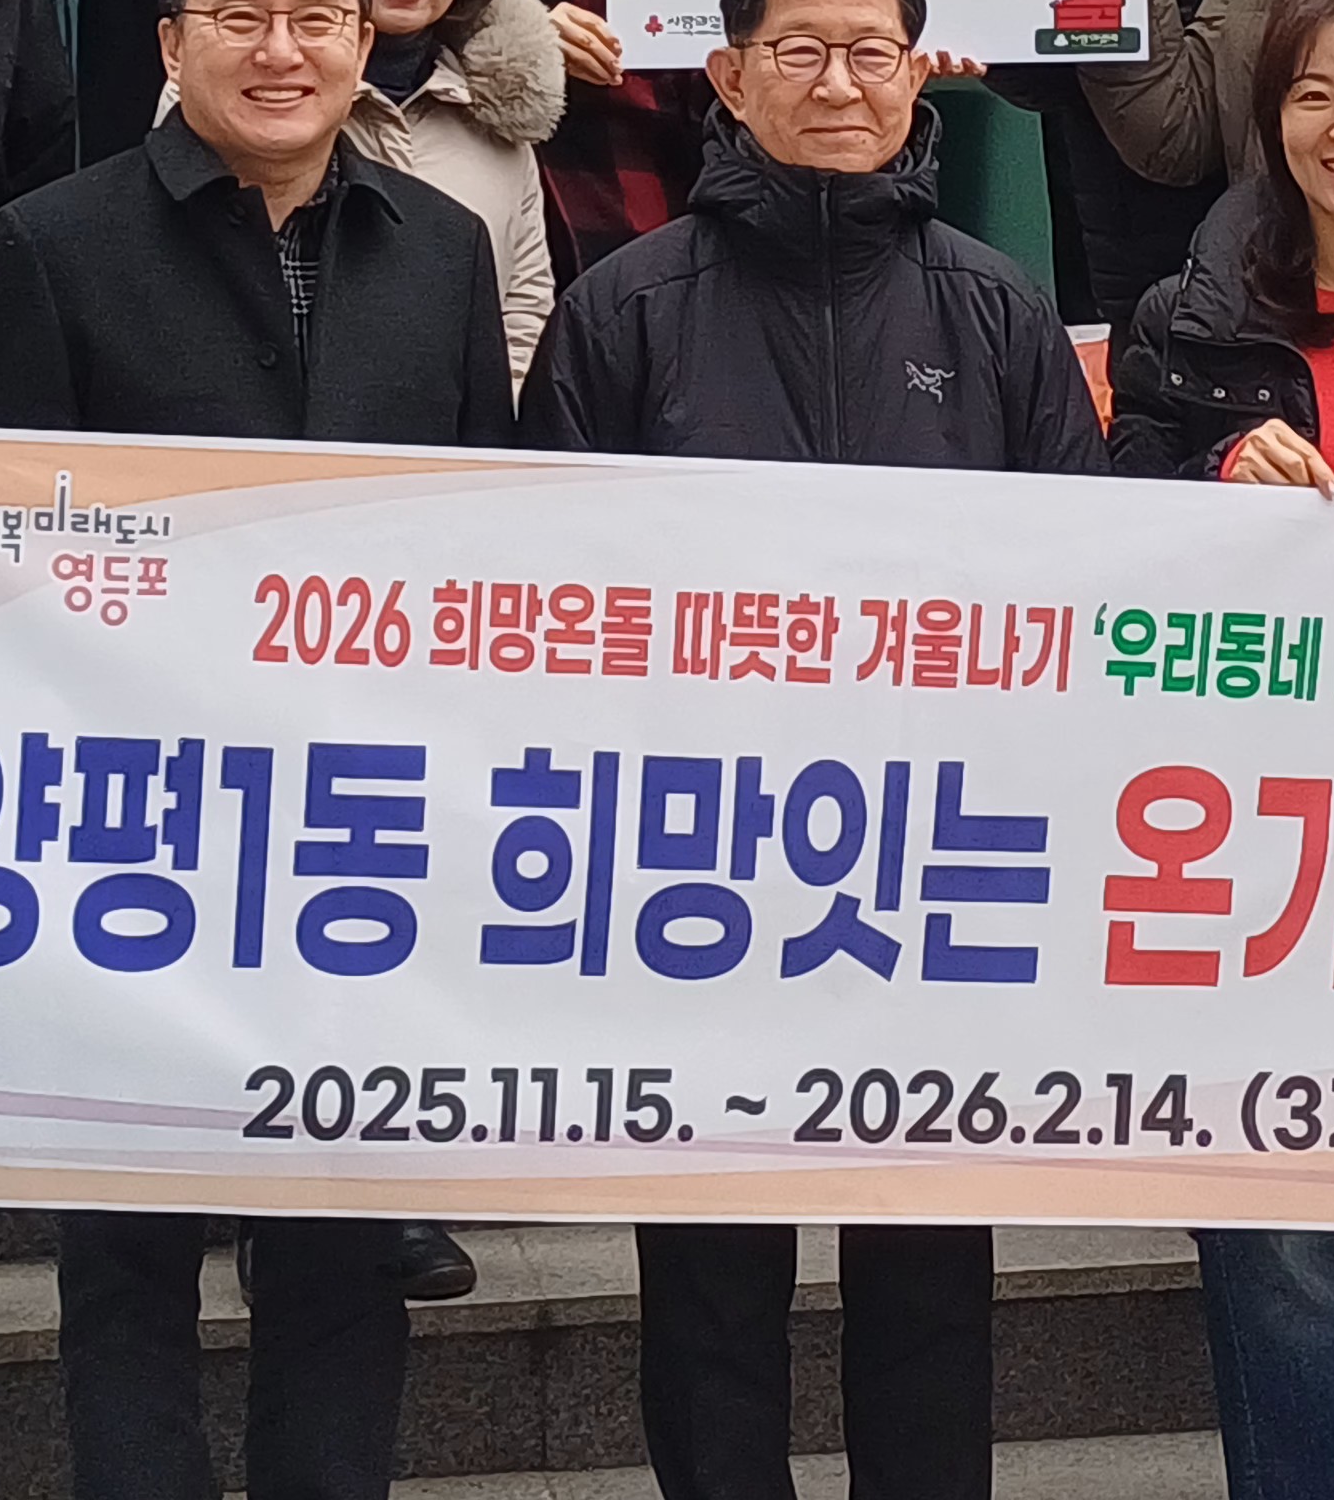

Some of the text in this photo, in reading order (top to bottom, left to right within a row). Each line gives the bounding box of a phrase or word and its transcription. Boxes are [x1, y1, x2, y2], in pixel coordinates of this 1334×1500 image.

[34, 475, 170, 544] 미래도시
[52, 553, 168, 627] 영등포
[252, 573, 411, 668] 2026
[429, 578, 653, 677] 희망온돌
[672, 591, 841, 685] 따뜻한
[856, 598, 1074, 693] 겨울나기
[479, 746, 1051, 984] 희망잇는
[242, 1065, 694, 1144] 2025.11.15.
[793, 1068, 1213, 1148] 2026.2.14.
